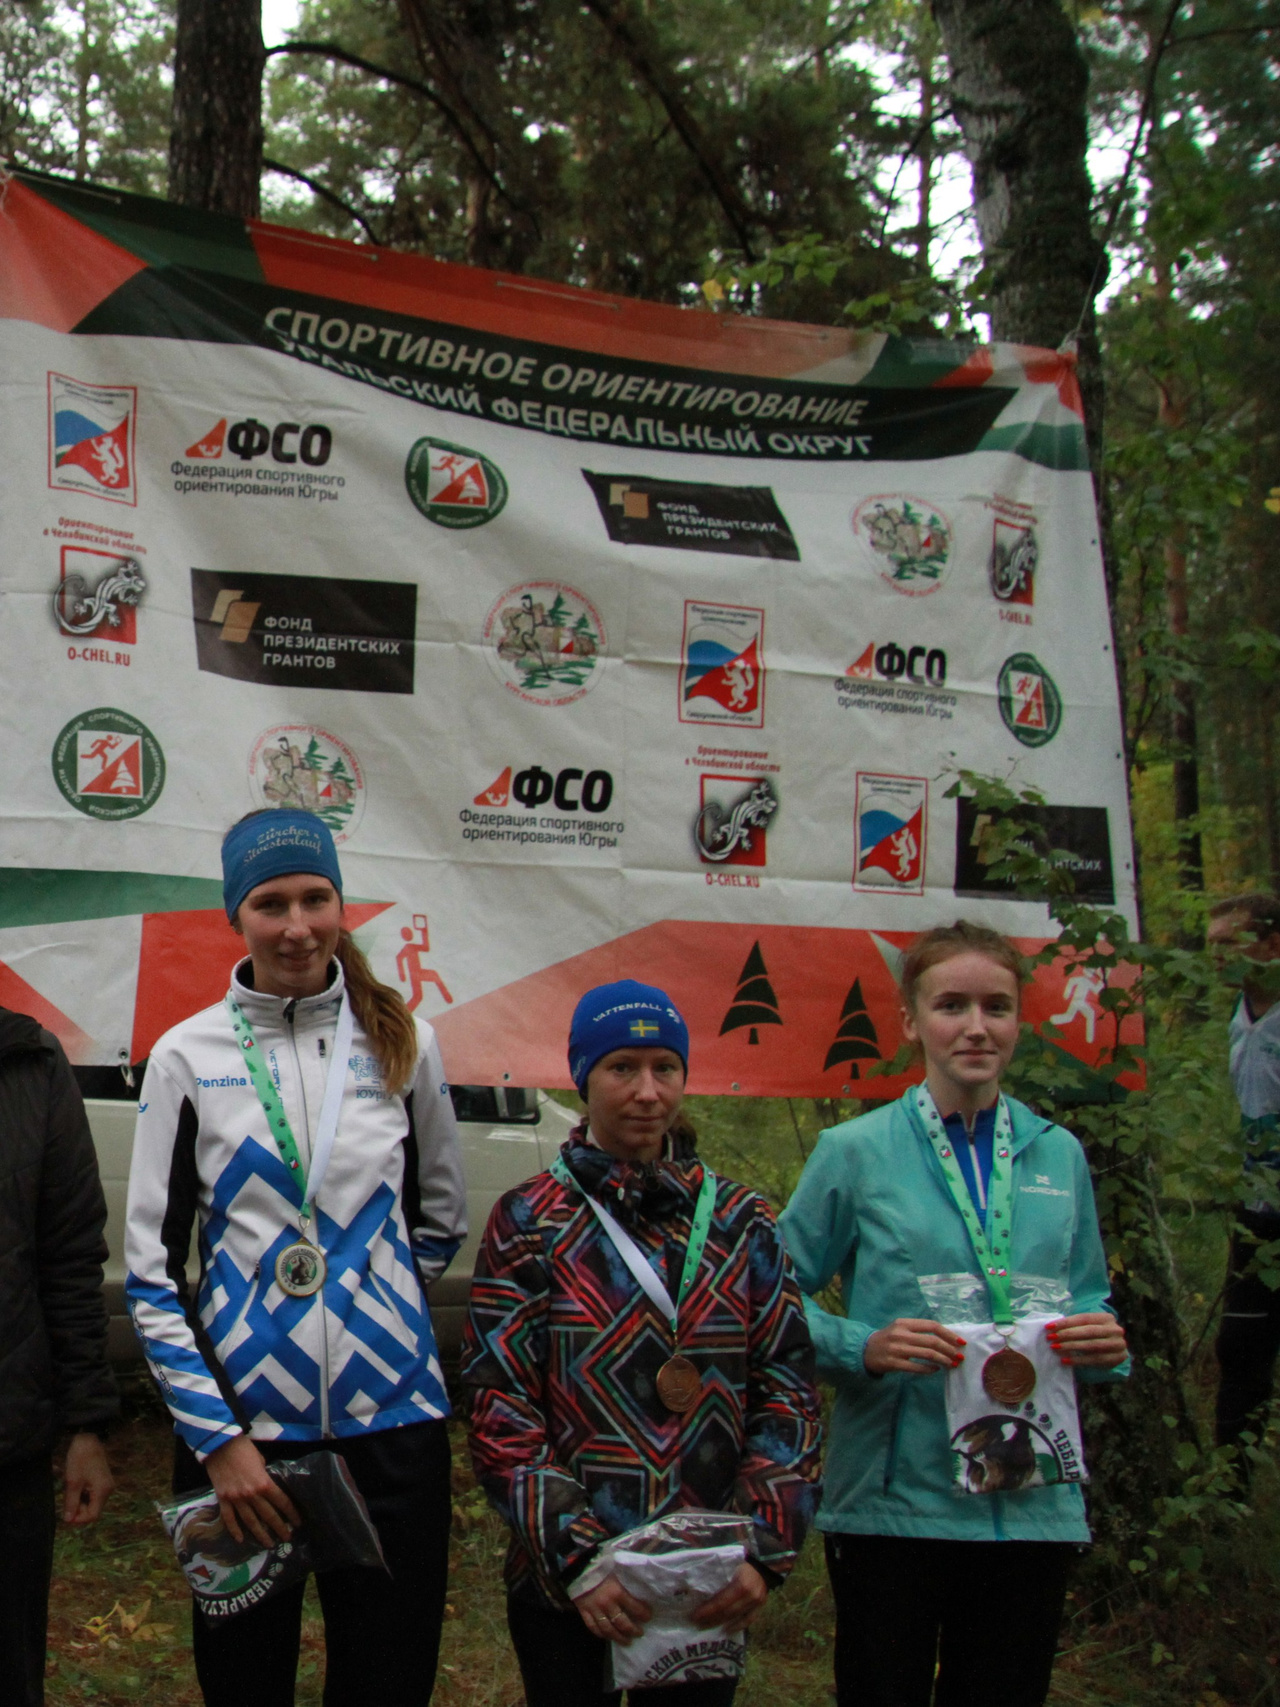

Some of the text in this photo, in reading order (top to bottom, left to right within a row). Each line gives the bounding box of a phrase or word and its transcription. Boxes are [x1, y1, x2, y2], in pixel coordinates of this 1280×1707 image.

[265, 307, 870, 427] СПОРТИВНОЕ ОРИЕНТИРОВАНИЕ
[491, 396, 762, 453] ФЕДЕРАЛЬНЫЙ
[768, 431, 873, 455] ОКРУГ
[228, 418, 332, 467] ФСО
[171, 460, 346, 488] Федерация спортивного
[174, 479, 339, 502] ориентирования Югры
[657, 501, 700, 515] ФОНД
[662, 512, 779, 532] ПРЕЗИДЕНТСКИХ
[666, 525, 731, 540] ГРАНТОВ
[264, 616, 313, 632] ФОНД
[263, 634, 401, 656] ПРЕЗИДЕНТСКИХ
[262, 653, 337, 669] ГРАНТОВ
[875, 642, 947, 688] ФСО
[834, 677, 895, 697] Федерация
[838, 695, 924, 715] ориентирования
[512, 765, 614, 813] ФСО
[459, 809, 625, 833] Федерация спортивного
[462, 827, 618, 850] ориентирования Югры
[592, 1002, 663, 1022] VATTENFALL
[268, 1048, 282, 1092] VICTORY
